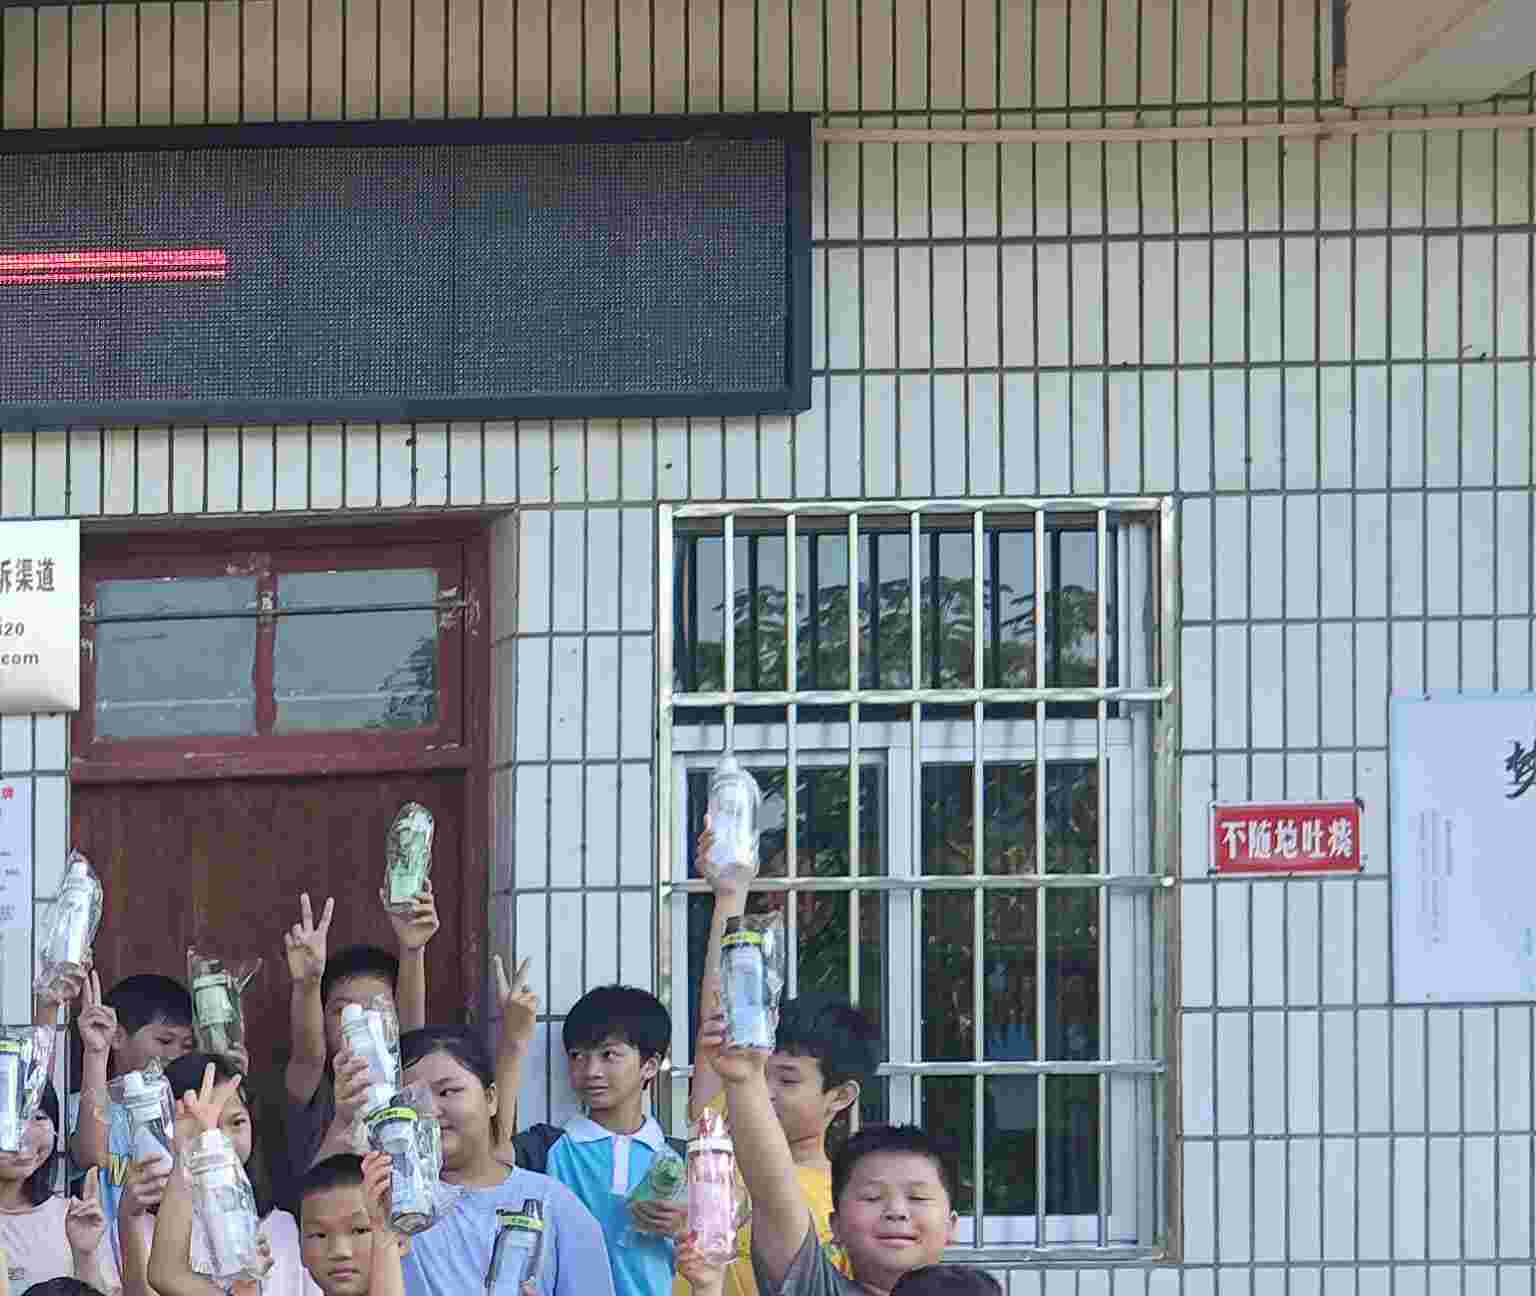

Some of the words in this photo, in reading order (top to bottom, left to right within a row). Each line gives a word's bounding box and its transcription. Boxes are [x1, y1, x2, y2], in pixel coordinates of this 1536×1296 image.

[1220, 814, 1354, 860] 不随地吐痰
